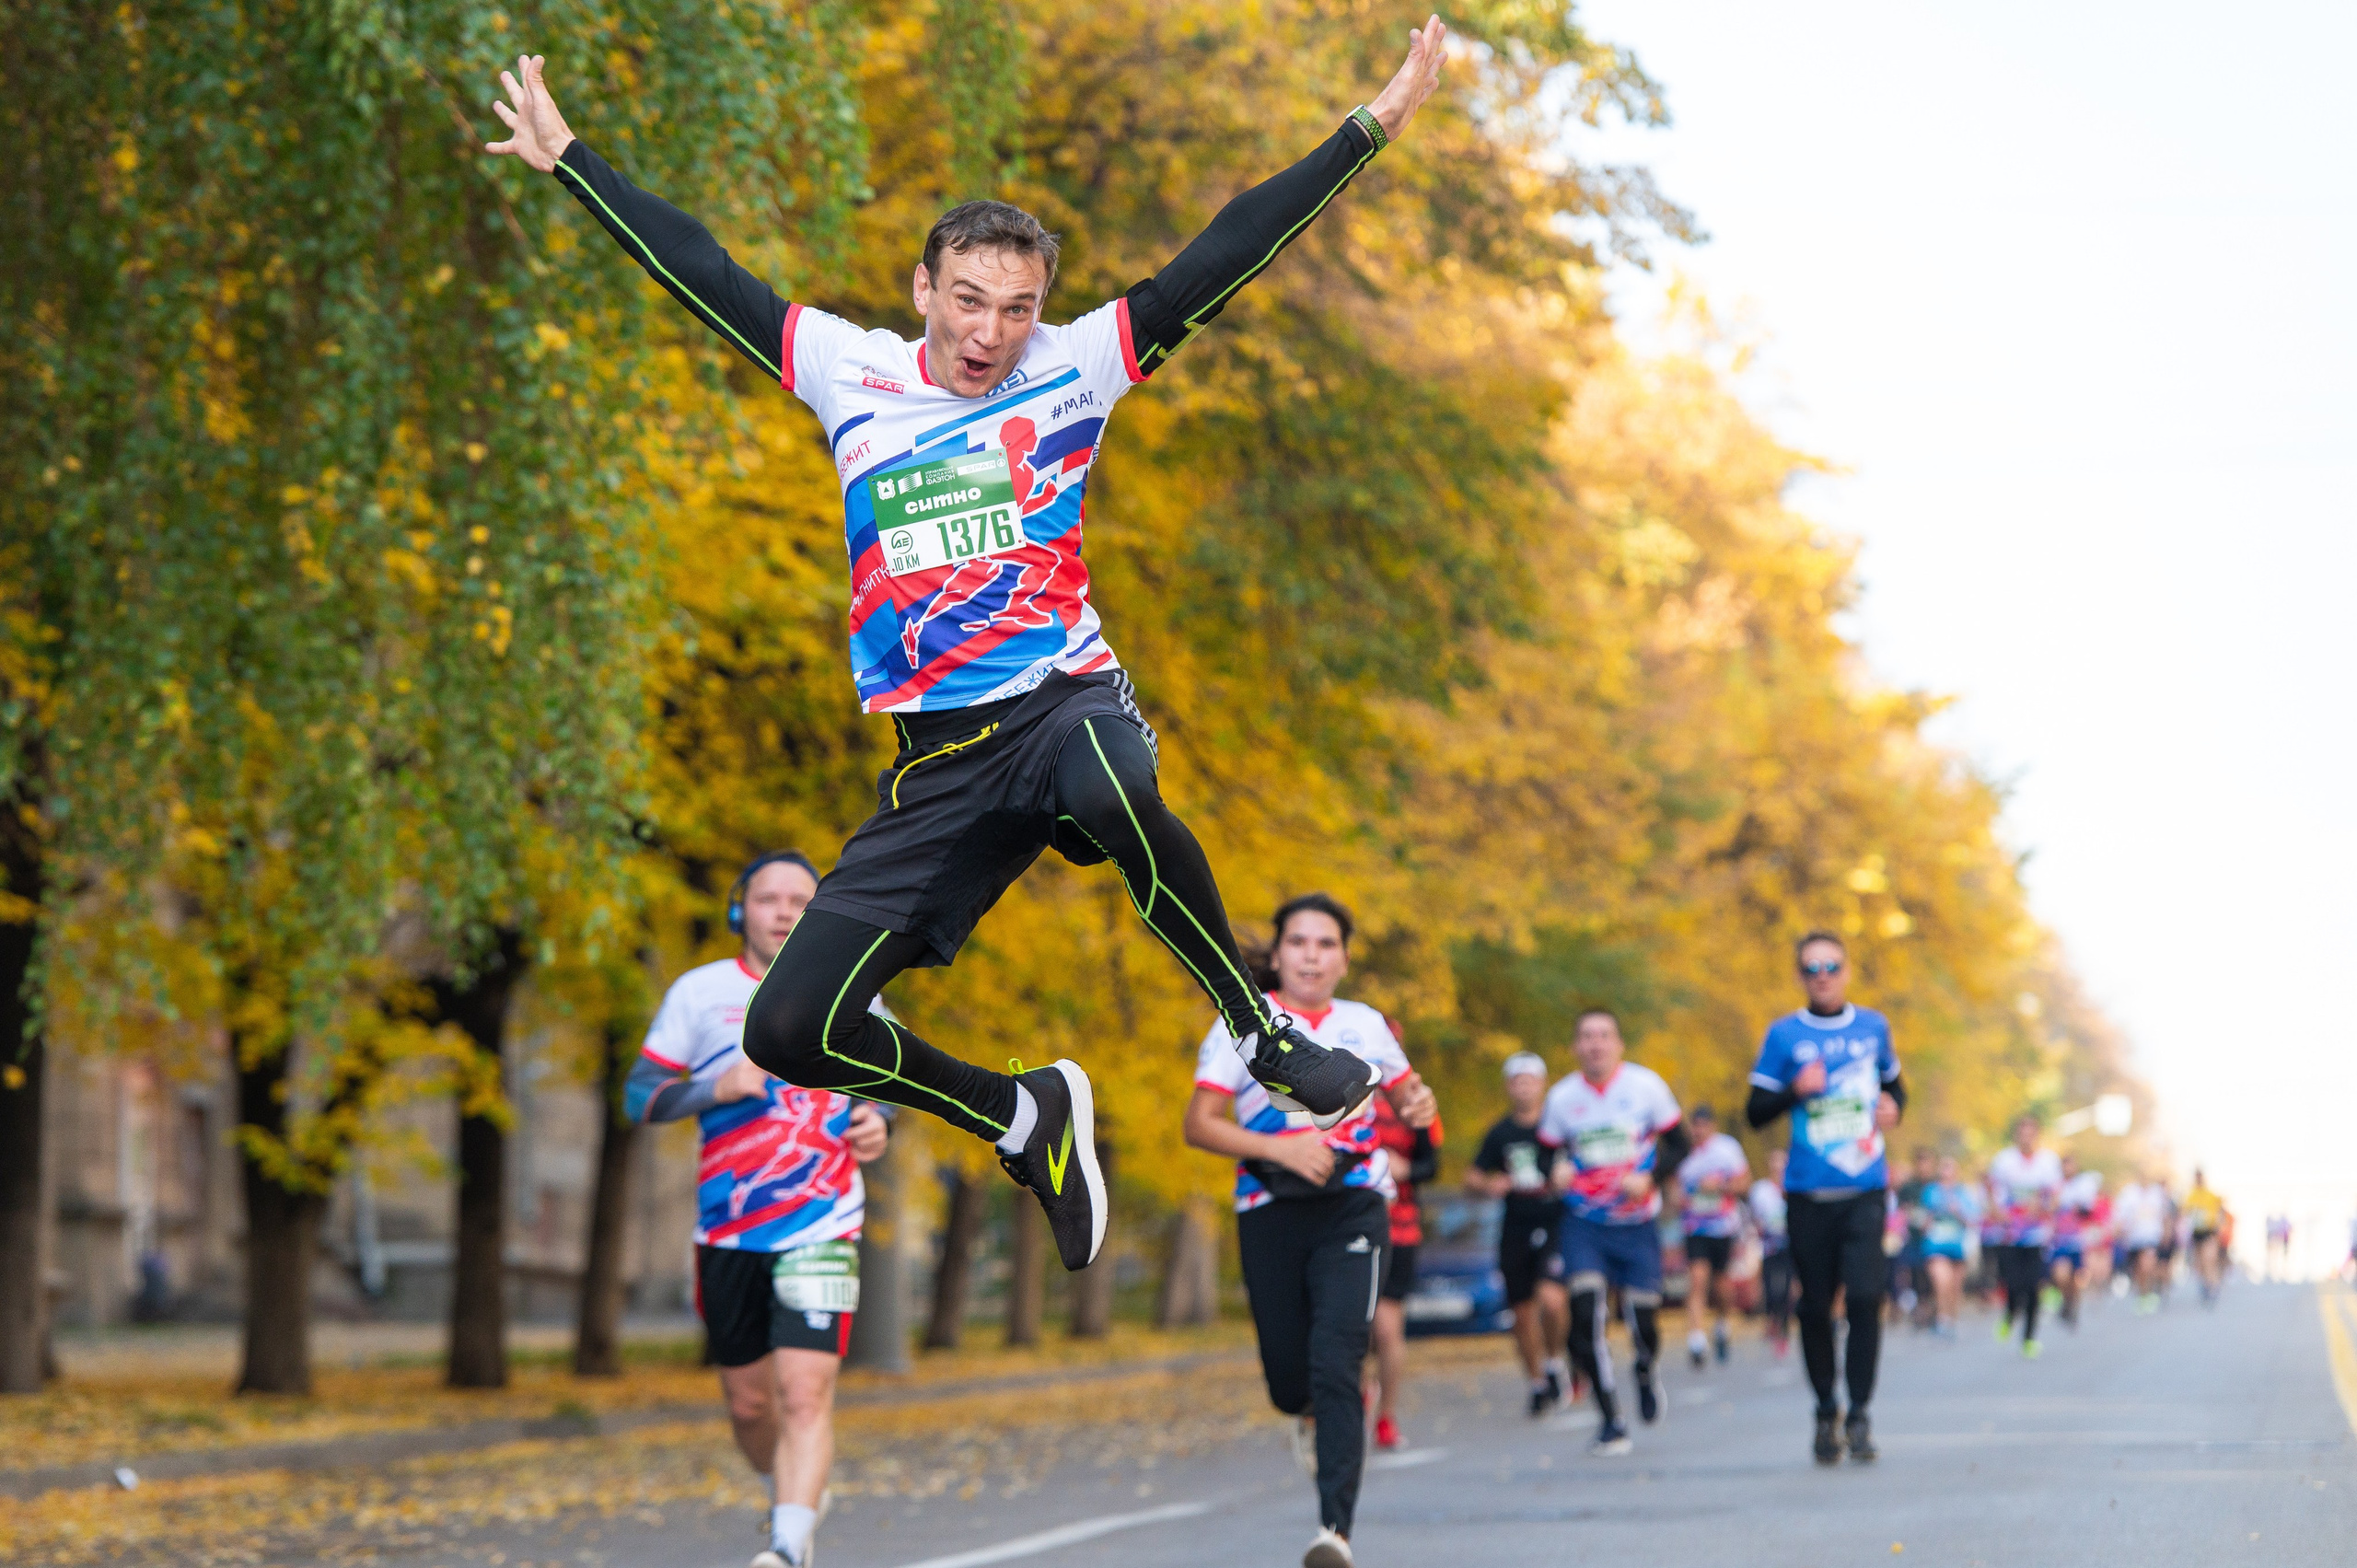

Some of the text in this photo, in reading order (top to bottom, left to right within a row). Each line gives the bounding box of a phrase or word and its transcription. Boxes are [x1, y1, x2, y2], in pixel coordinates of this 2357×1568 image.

[866, 377, 903, 393] SPAR
[1051, 390, 1102, 420] #МАГ
[966, 461, 995, 472] SPAR
[925, 474, 956, 485] ФАЭТОН
[936, 508, 1016, 561] 1376
[893, 556, 903, 573] 10
[993, 660, 1056, 702] БЕЖИТ
